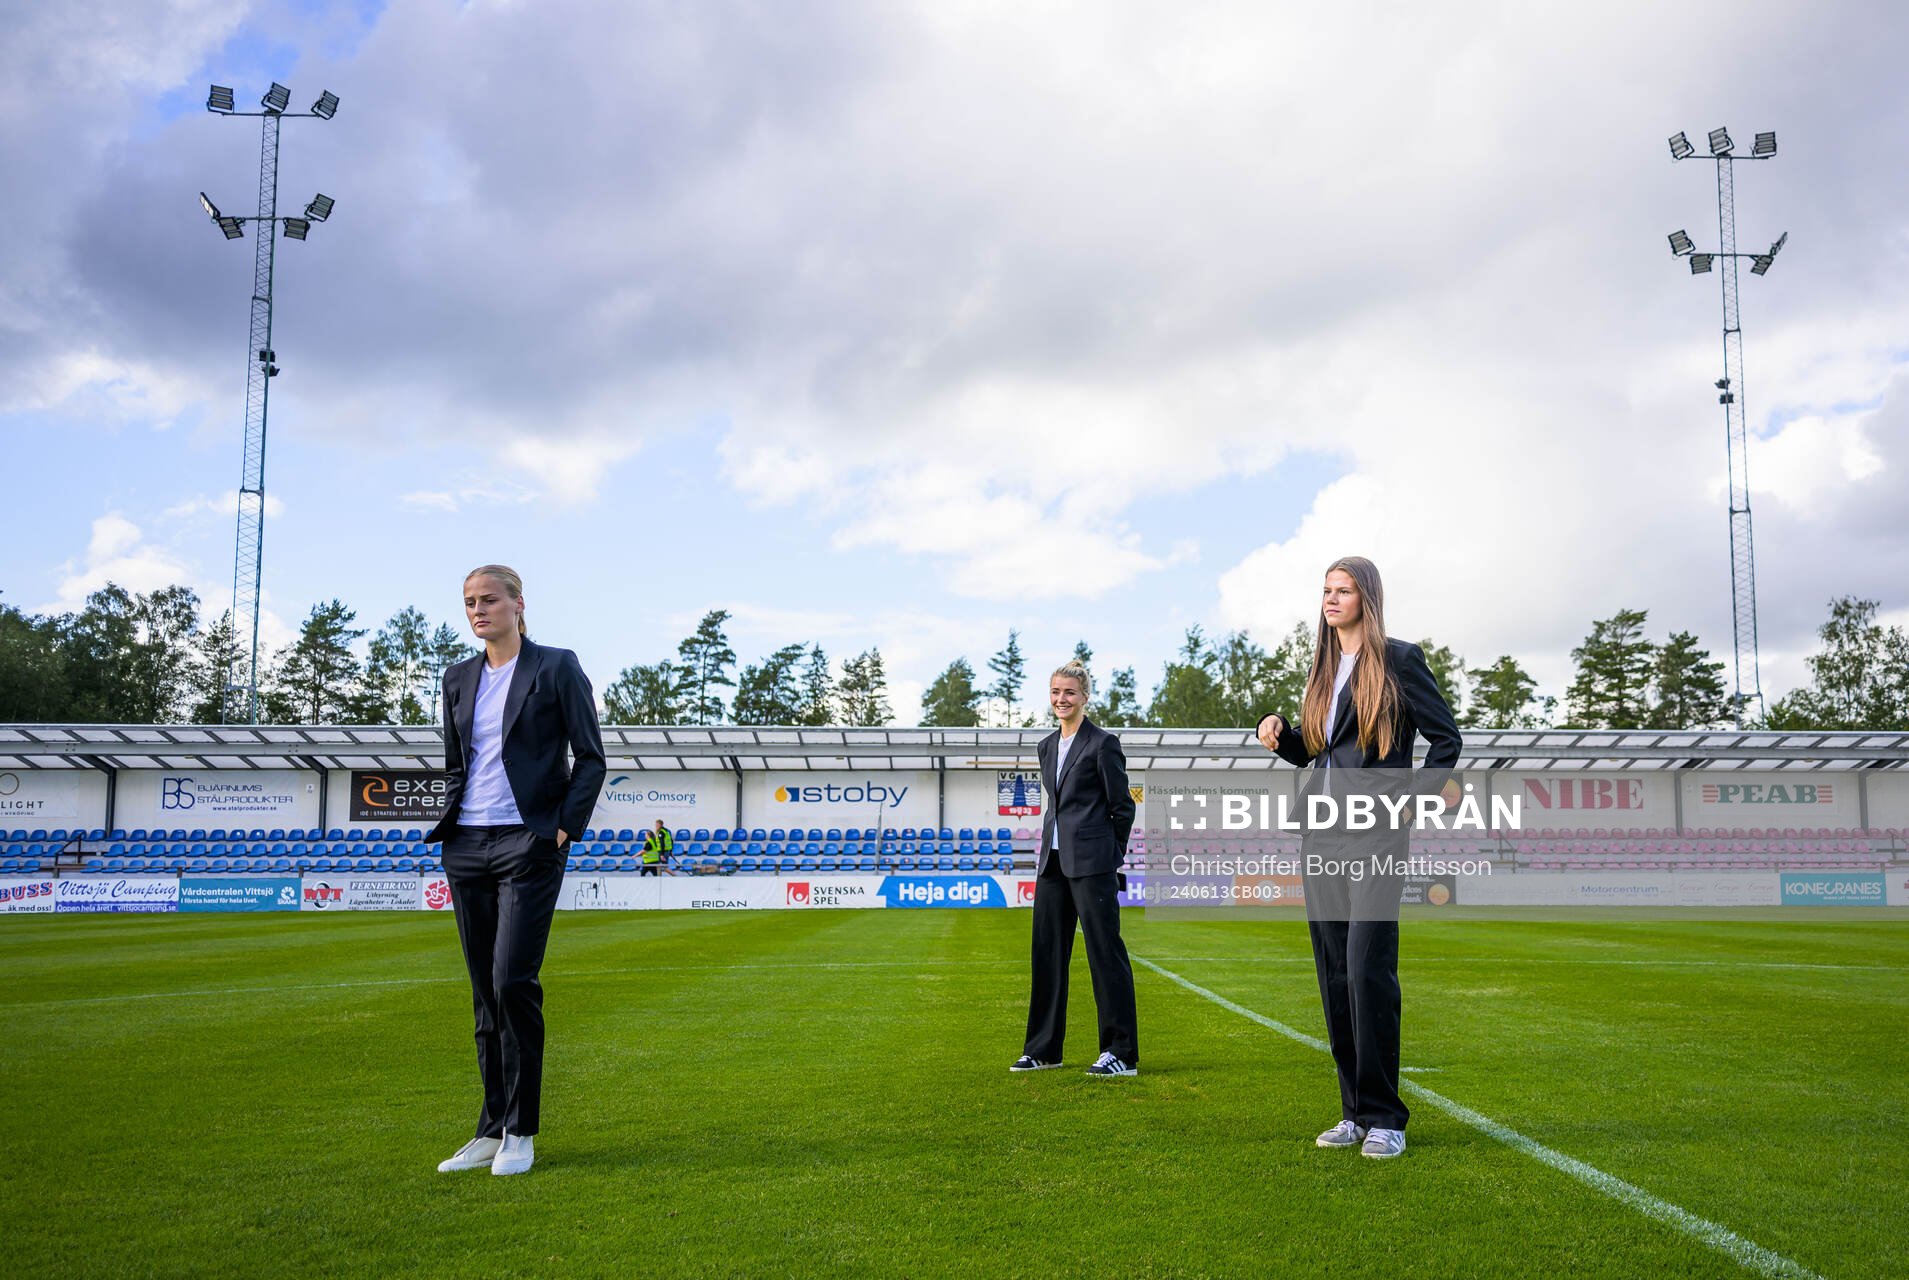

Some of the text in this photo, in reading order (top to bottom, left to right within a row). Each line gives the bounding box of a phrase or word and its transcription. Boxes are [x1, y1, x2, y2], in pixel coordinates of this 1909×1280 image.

[197, 784, 263, 792] BJÄRNUMS
[393, 779, 446, 793] exa
[1148, 785, 1269, 795] Hässleholms kommun
[605, 790, 696, 804] Vittsjö Omsorg
[802, 781, 908, 808] stoby
[1522, 778, 1644, 810] NIBE
[1717, 784, 1818, 804] PEAB
[197, 795, 293, 804] STÅLPRODUKTER
[393, 795, 446, 807] crea
[58, 879, 177, 899] Vittsjö Camping
[351, 881, 416, 890] FERNEBRAND
[814, 886, 865, 895] SVENSKA
[1580, 885, 1659, 893] Motorcentrum
[1785, 882, 1881, 896] KONECRANES
[181, 887, 274, 897] Vårdcentralen Vittsjö
[899, 881, 988, 904] Heja dig!
[691, 900, 748, 908] ERIDAN
[814, 896, 840, 905] SPEL
[18, 904, 35, 912] med
[37, 904, 52, 912] oss!
